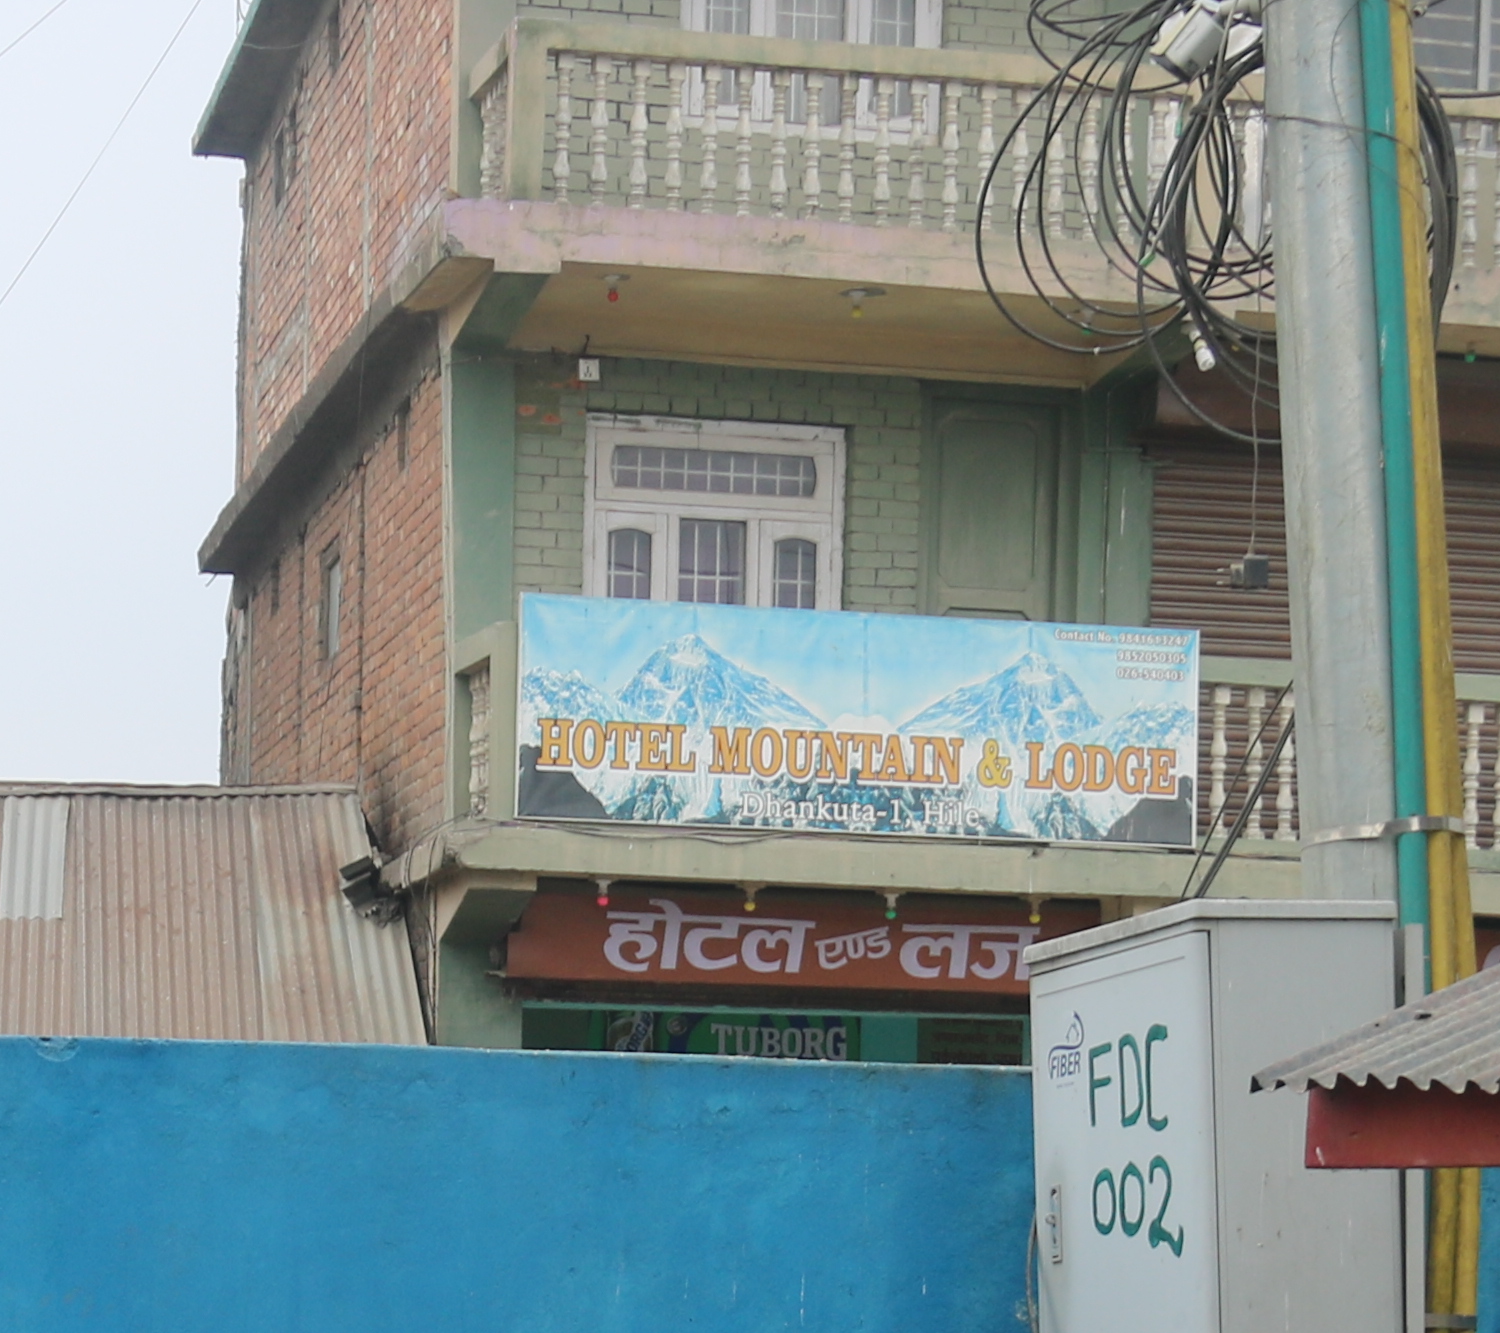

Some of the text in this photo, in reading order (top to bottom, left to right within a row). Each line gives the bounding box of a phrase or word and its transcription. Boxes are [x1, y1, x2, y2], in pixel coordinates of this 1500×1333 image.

[1054, 628, 1094, 641] Contact
[1116, 650, 1187, 664] 9852050305
[1116, 667, 1184, 681] 026-540403
[535, 717, 1178, 796] HOTEL MOUNTAIN & LODGE
[922, 796, 980, 828] Hile
[602, 899, 816, 974] होटल
[814, 925, 893, 970] एण्ड
[710, 1022, 847, 1060] TUBORG
[1050, 1051, 1081, 1080] FIBER
[1087, 1023, 1169, 1132] FDC
[1092, 1154, 1184, 1258] 002
